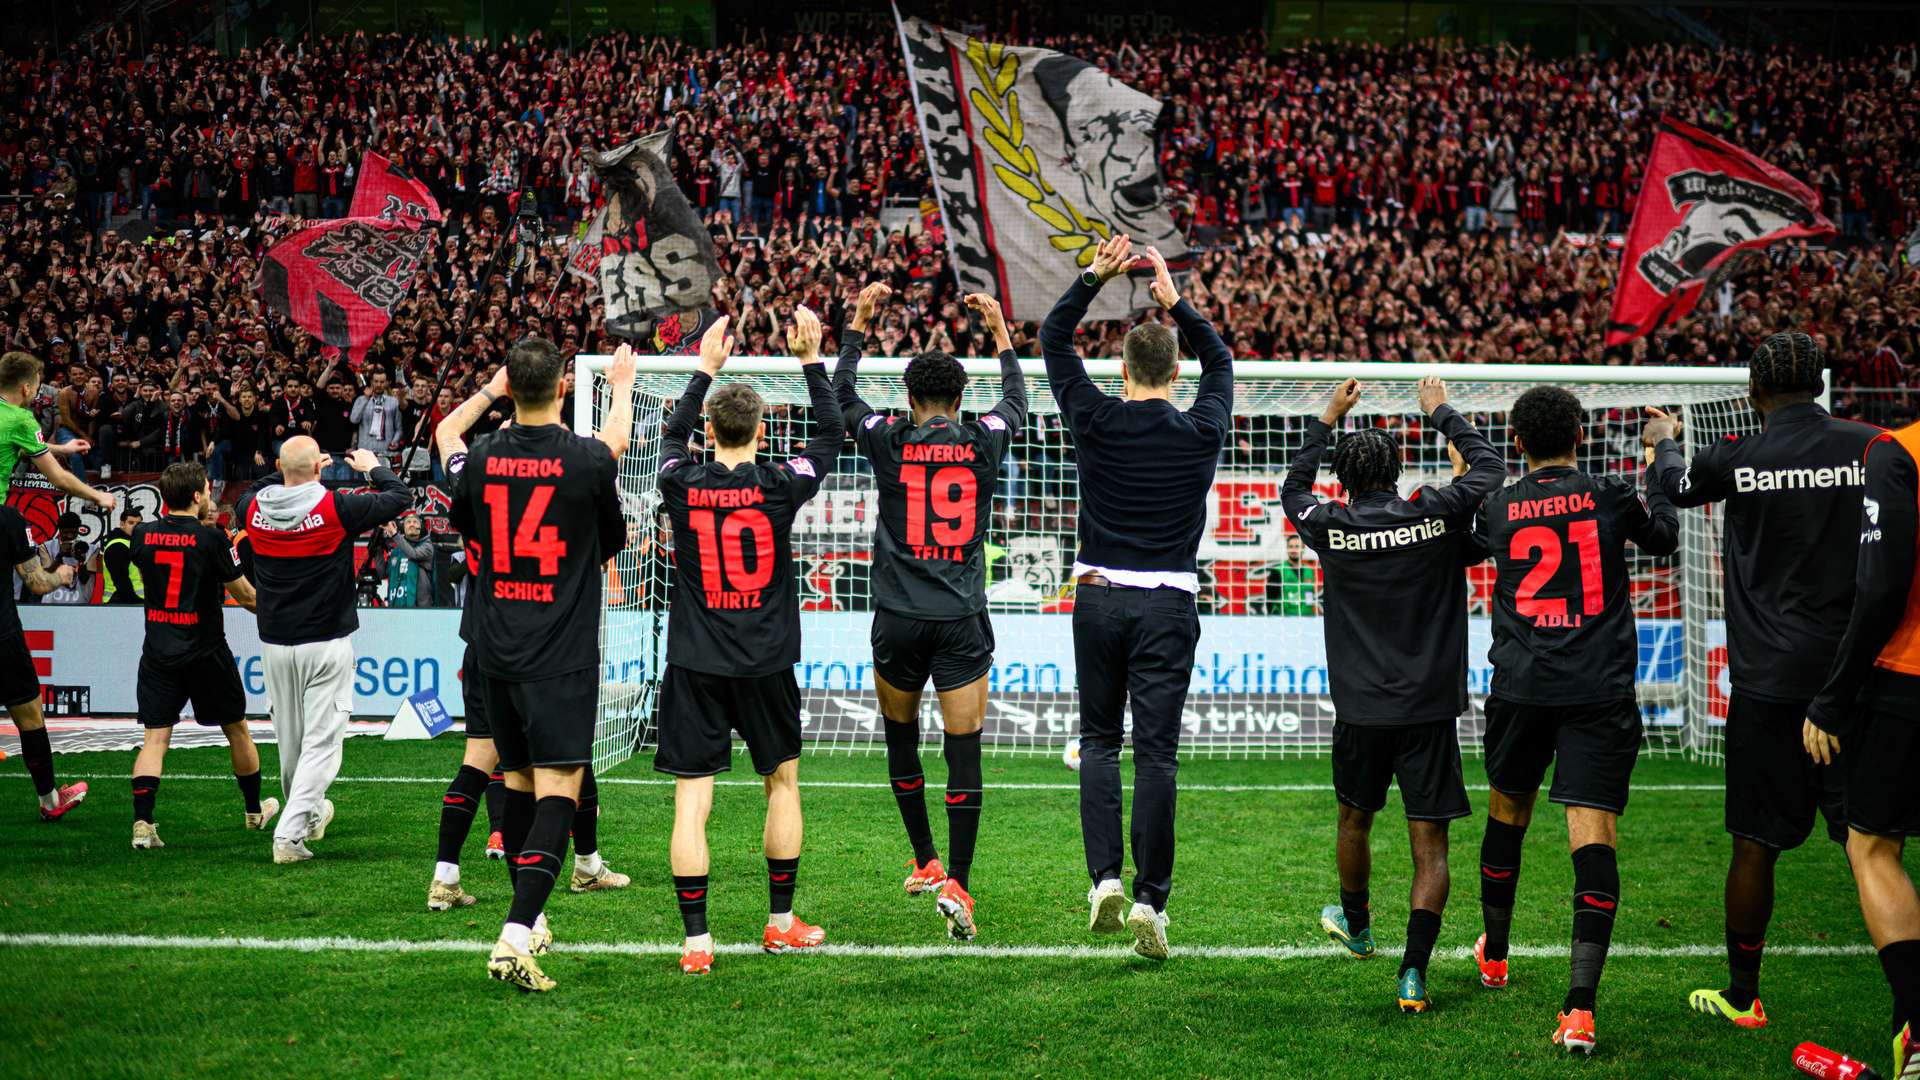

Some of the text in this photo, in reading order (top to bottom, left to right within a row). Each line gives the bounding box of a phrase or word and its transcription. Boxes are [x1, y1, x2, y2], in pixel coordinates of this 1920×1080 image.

[898, 463, 977, 546] 19
[483, 483, 567, 576] 14
[688, 508, 775, 593] 10
[1327, 518, 1447, 551] Barmenia
[154, 550, 185, 609] 7
[494, 580, 554, 602] SCHICK
[1510, 519, 1604, 618] 21
[705, 590, 763, 609] WIRTZ
[1534, 613, 1582, 628] ADLI
[1207, 704, 1299, 733] trive
